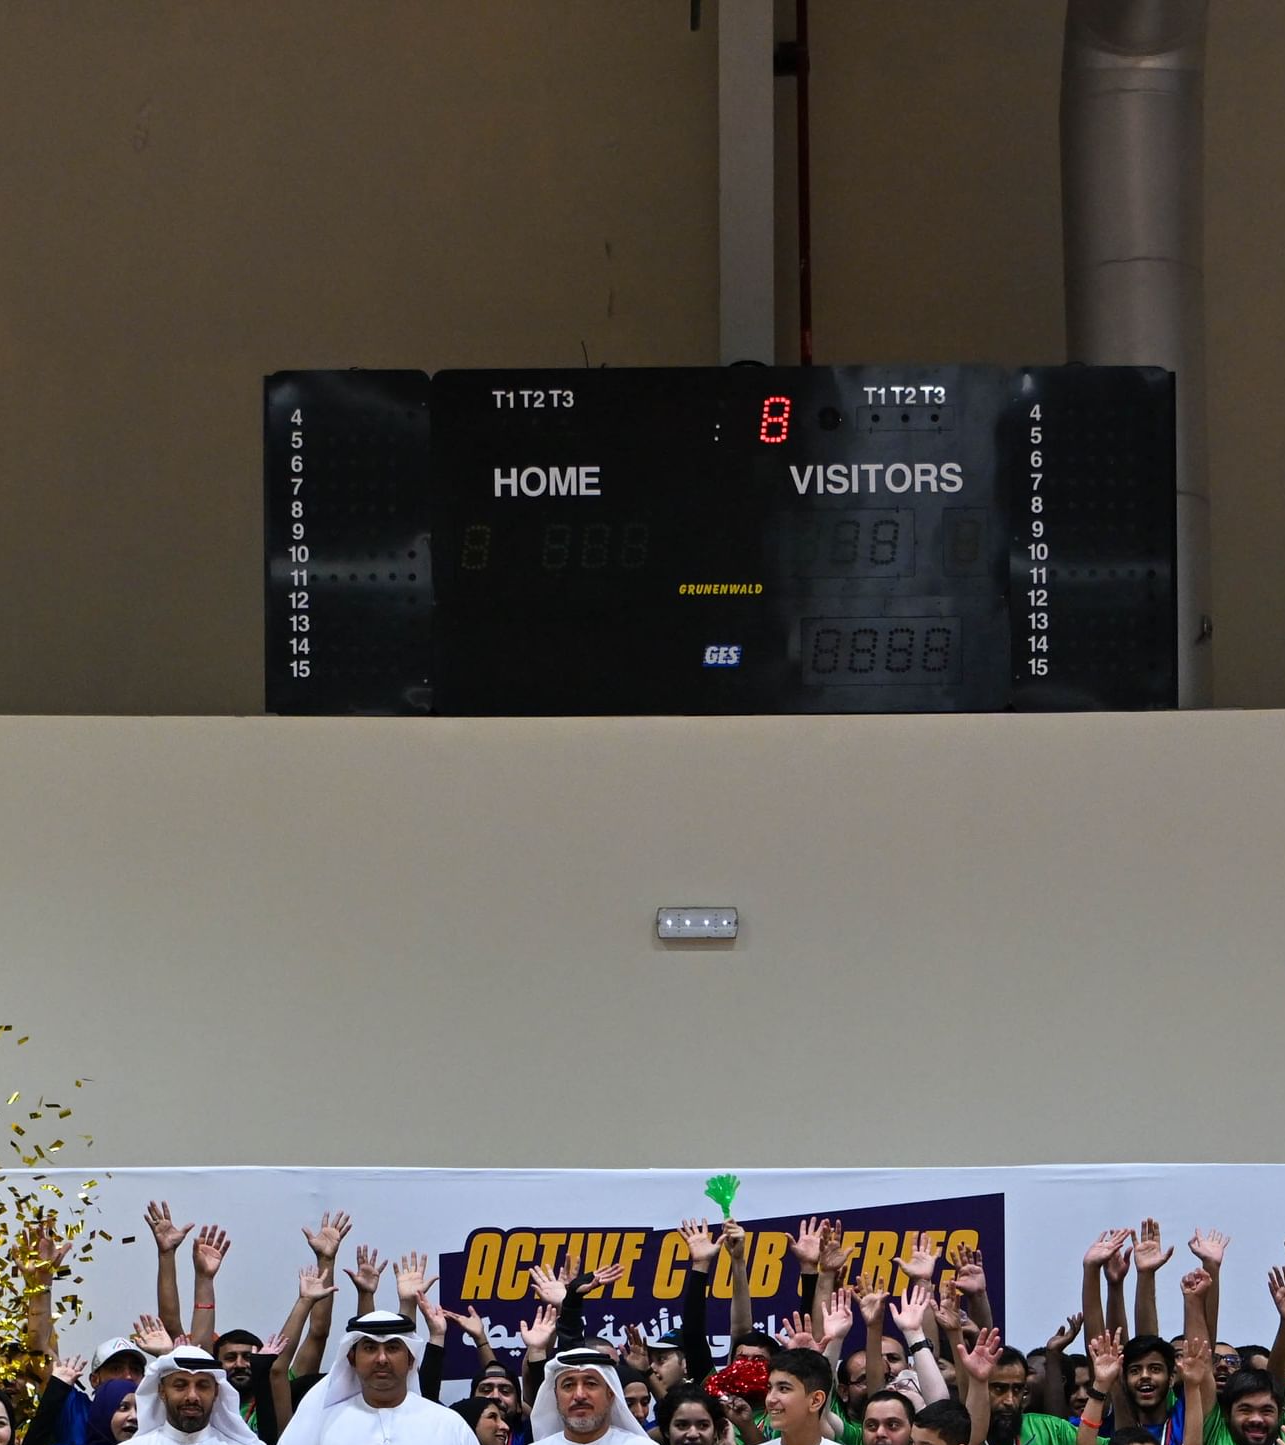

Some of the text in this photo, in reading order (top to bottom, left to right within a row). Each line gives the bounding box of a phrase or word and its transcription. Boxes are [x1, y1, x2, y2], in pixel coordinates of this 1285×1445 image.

[491, 389, 574, 409] T1 T2 T3
[863, 385, 946, 405] T1 T2 T3
[290, 409, 303, 426] 4
[760, 396, 791, 443] 8
[1029, 404, 1042, 421] 4
[291, 431, 303, 449] 5
[1030, 427, 1042, 444] 5
[291, 455, 303, 473] 6
[1030, 450, 1043, 468] 6
[291, 478, 303, 495] 7
[494, 466, 601, 497] HOME
[789, 462, 963, 494] VISITORS
[1030, 473, 1043, 491] 7
[291, 501, 303, 518] 8
[1031, 496, 1043, 514] 8
[292, 523, 304, 540] 9
[1032, 520, 1044, 538] 9
[288, 545, 309, 563] 10
[1027, 543, 1048, 561] 10
[290, 569, 307, 586] 11
[1029, 567, 1046, 584] 11
[678, 583, 763, 595] GRUNENWALD
[1027, 589, 1048, 606] 12
[288, 591, 309, 609] 12
[289, 614, 310, 632] 13
[1028, 612, 1049, 630] 13
[289, 637, 310, 655] 14
[1027, 635, 1049, 653] 14
[704, 645, 739, 665] GES
[289, 660, 310, 678] 15
[1027, 658, 1048, 676] 15
[652, 1230, 788, 1299] CUB
